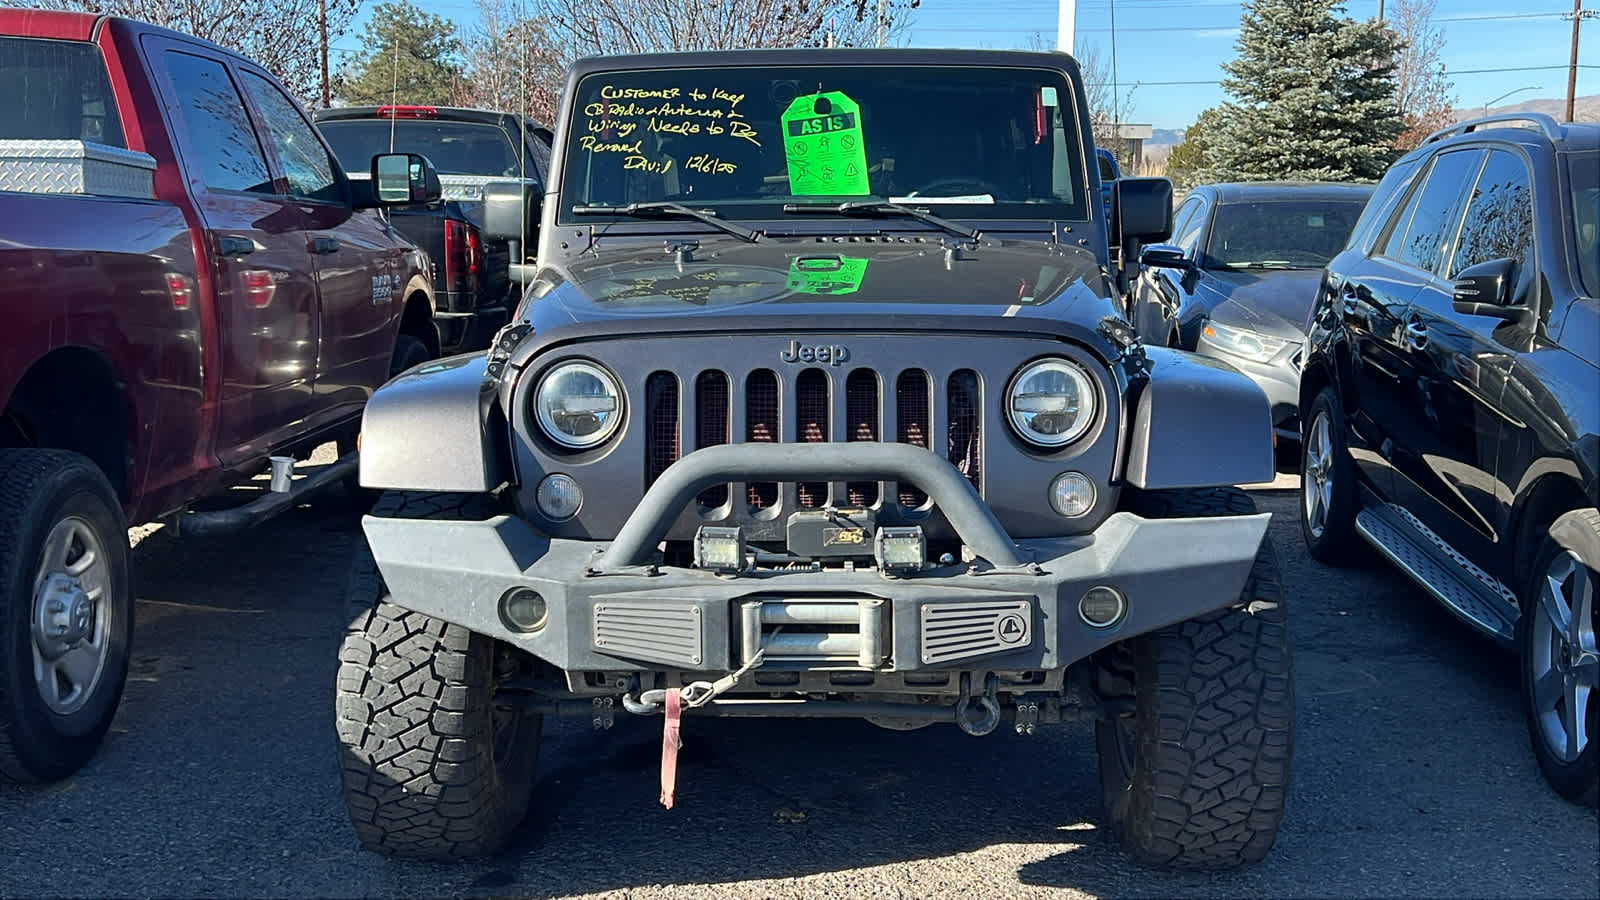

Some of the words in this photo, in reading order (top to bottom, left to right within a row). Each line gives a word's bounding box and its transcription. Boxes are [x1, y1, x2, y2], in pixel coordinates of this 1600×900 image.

[601, 85, 680, 99] CUSTOMER
[688, 87, 707, 101] to
[584, 102, 604, 116] CB
[706, 120, 725, 135] to
[801, 119, 823, 134] AS
[826, 116, 844, 131] IS
[685, 153, 738, 175] 12/6/25
[780, 338, 850, 367] Jeep
